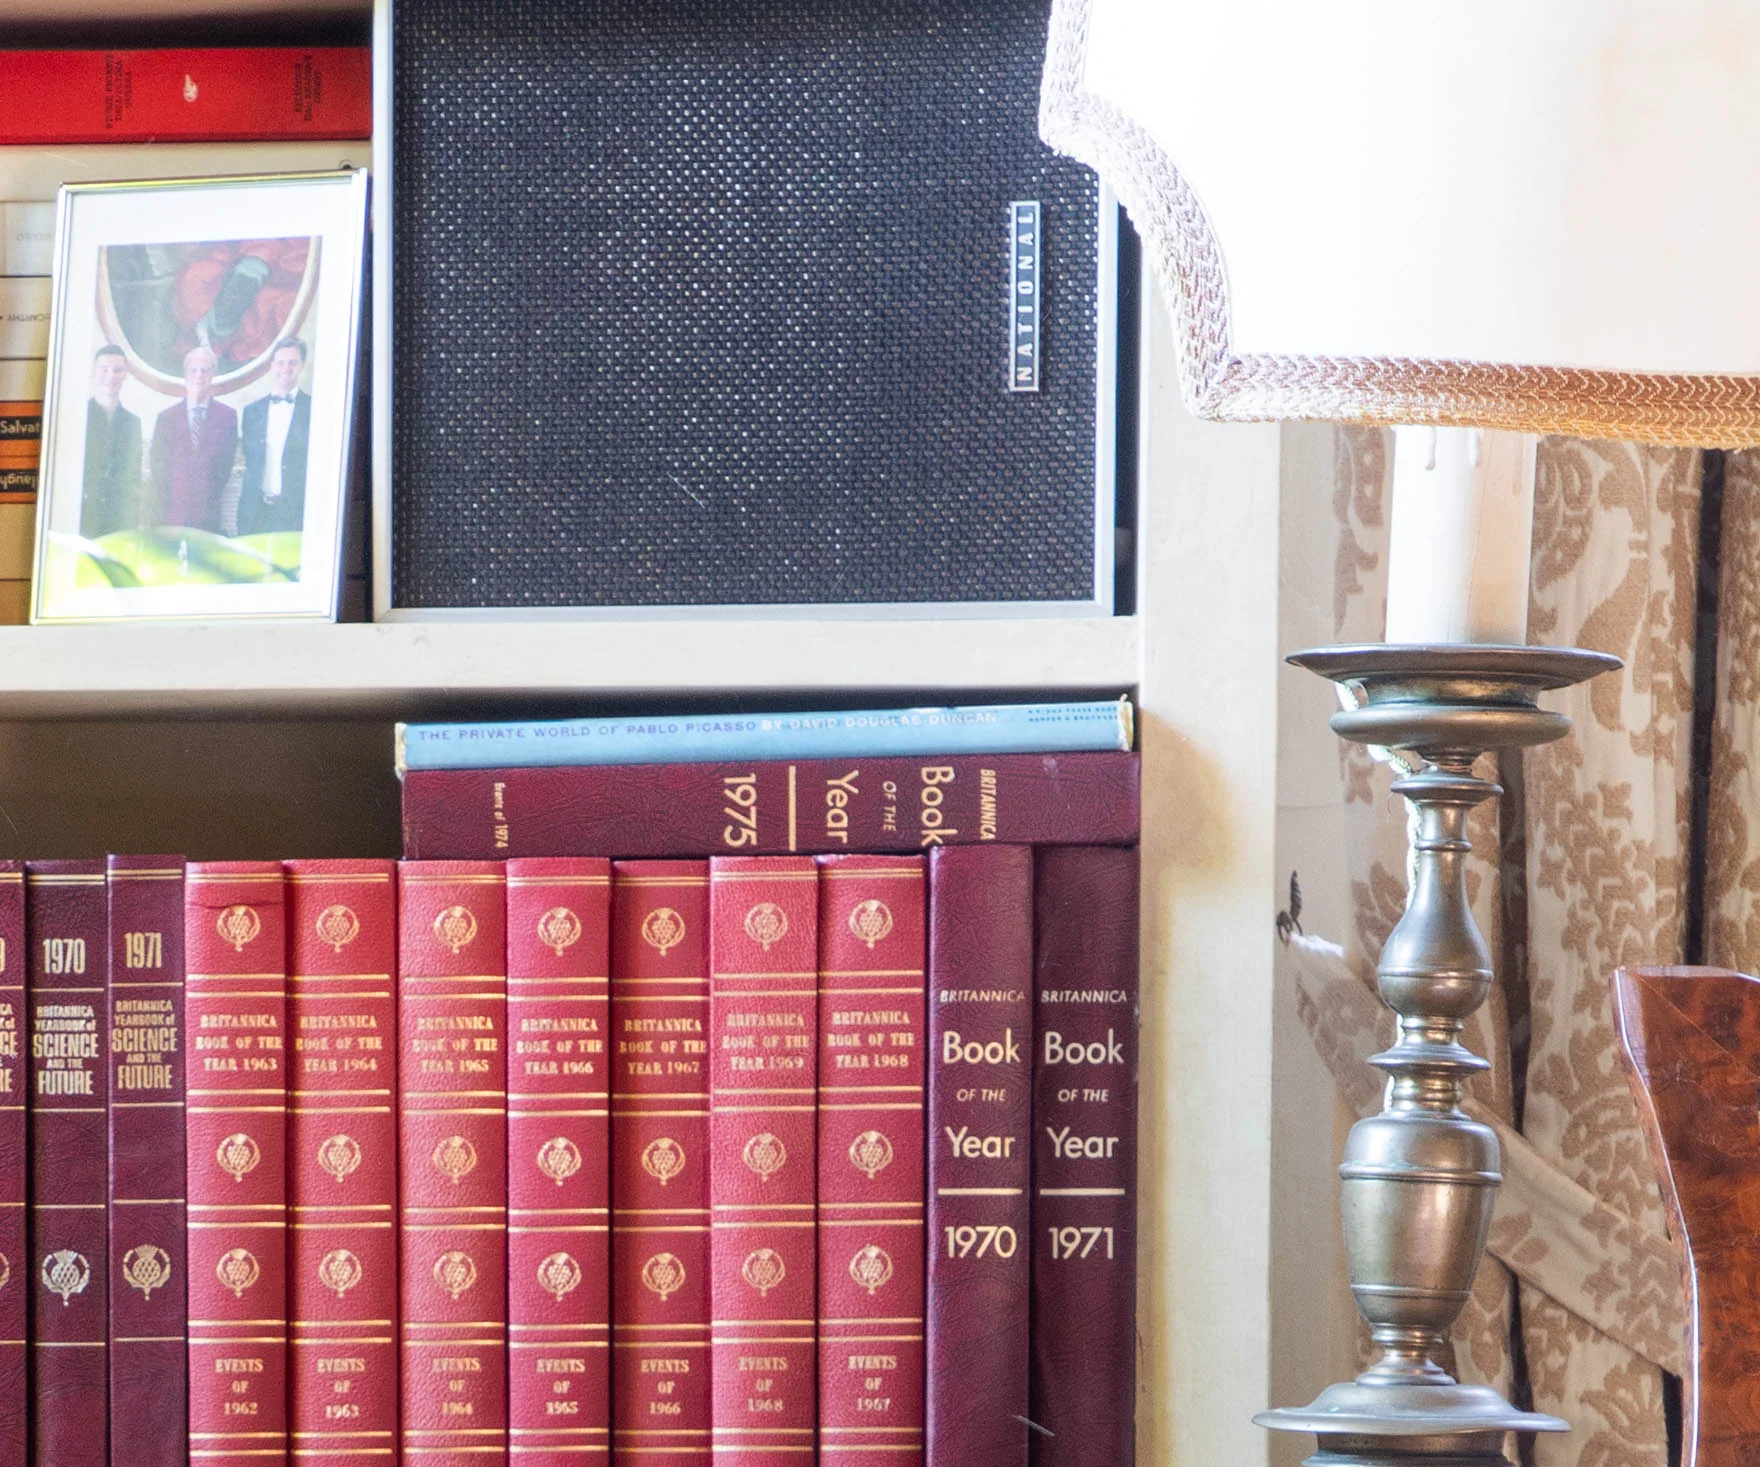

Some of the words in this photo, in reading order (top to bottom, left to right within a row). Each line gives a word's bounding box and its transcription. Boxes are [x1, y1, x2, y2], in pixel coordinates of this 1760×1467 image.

[1016, 211, 1035, 383] NATIONAL
[419, 731, 450, 741] THE
[459, 728, 526, 739] PRIVATE
[533, 726, 590, 738] WORLD
[626, 723, 678, 735] PABLO
[686, 720, 757, 733] PICASSO
[723, 773, 757, 847] 1975
[826, 770, 859, 844] Year
[920, 766, 958, 846] Book
[980, 769, 997, 840] BRITANNICA
[883, 805, 896, 831] THE
[44, 939, 85, 974] 1970
[126, 933, 162, 969] 1971
[940, 989, 1025, 1004] BRITANNICA
[1041, 989, 1127, 1004] BRITANNICA
[200, 1015, 277, 1028] BRITANNICA
[33, 1034, 98, 1058] SCIENCE
[112, 1029, 177, 1053] SCIENCE
[943, 1031, 1020, 1065] Book
[1044, 1031, 1124, 1065] Book
[244, 1058, 277, 1070] 1963
[668, 1062, 699, 1074] 1967
[874, 1054, 908, 1067] 1968
[38, 1070, 94, 1095] FUTURE
[118, 1065, 173, 1089] FUTURE
[956, 1089, 975, 1102] OF
[981, 1089, 1005, 1102] THE
[1058, 1089, 1077, 1102] OF
[1083, 1089, 1109, 1102] THE
[946, 1127, 1016, 1159] Year
[1047, 1127, 1118, 1159] Year
[946, 1226, 1017, 1259] 1970
[1049, 1227, 1113, 1260] 1971
[215, 1359, 263, 1372] EVENTS
[641, 1360, 689, 1372] EVENTS
[224, 1403, 258, 1414] 1962
[325, 1406, 359, 1418] 1963
[649, 1402, 681, 1414] 1966
[858, 1399, 891, 1411] 1967
